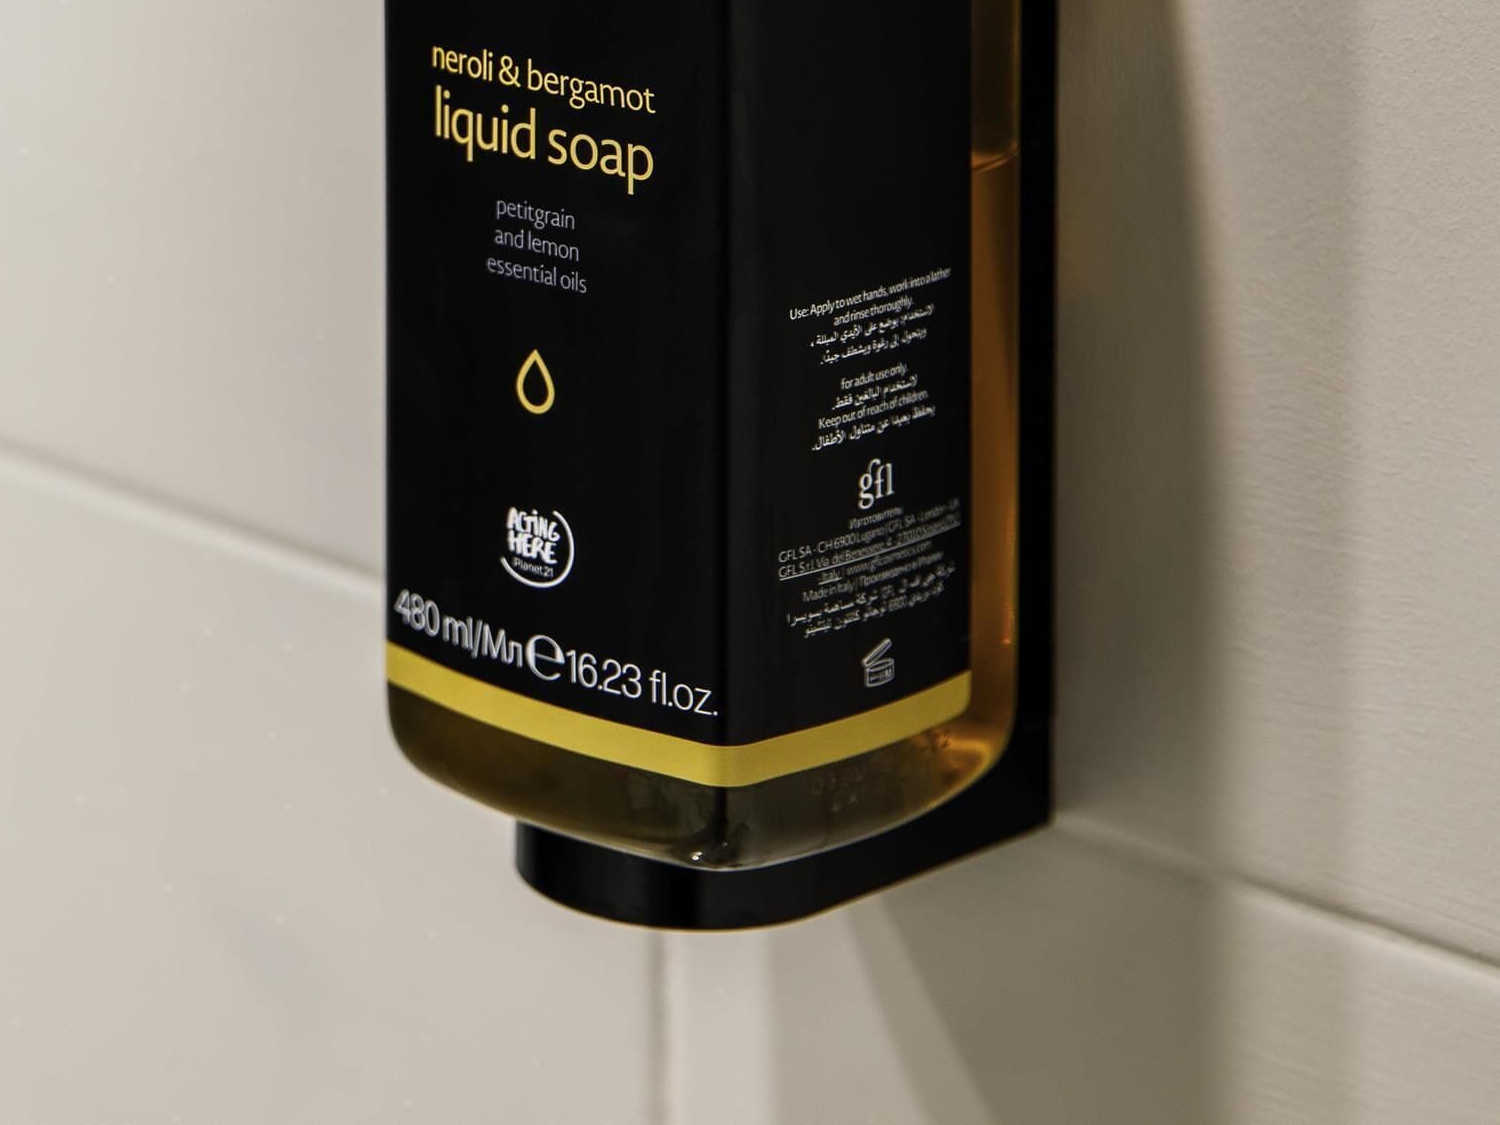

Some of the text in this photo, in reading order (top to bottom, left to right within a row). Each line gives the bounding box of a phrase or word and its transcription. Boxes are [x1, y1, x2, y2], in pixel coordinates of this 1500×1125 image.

[432, 45, 656, 113] neroli & bergamot
[435, 84, 654, 195] liquid soap
[496, 199, 575, 229] petitgrain
[494, 228, 579, 261] and lemon
[487, 257, 587, 293] essential oils
[810, 299, 835, 316] Apply
[835, 298, 846, 309] to
[845, 294, 862, 307] wet
[834, 313, 850, 326] and
[850, 308, 870, 323] rinse
[854, 371, 874, 387] adult
[875, 369, 890, 382] use
[818, 416, 841, 431] Keep
[842, 410, 856, 423] out
[857, 407, 866, 420] of
[867, 401, 888, 416] reach
[858, 458, 896, 510] gfl
[507, 530, 558, 564] HERE
[394, 589, 440, 637] 480
[566, 649, 642, 698] 16.23
